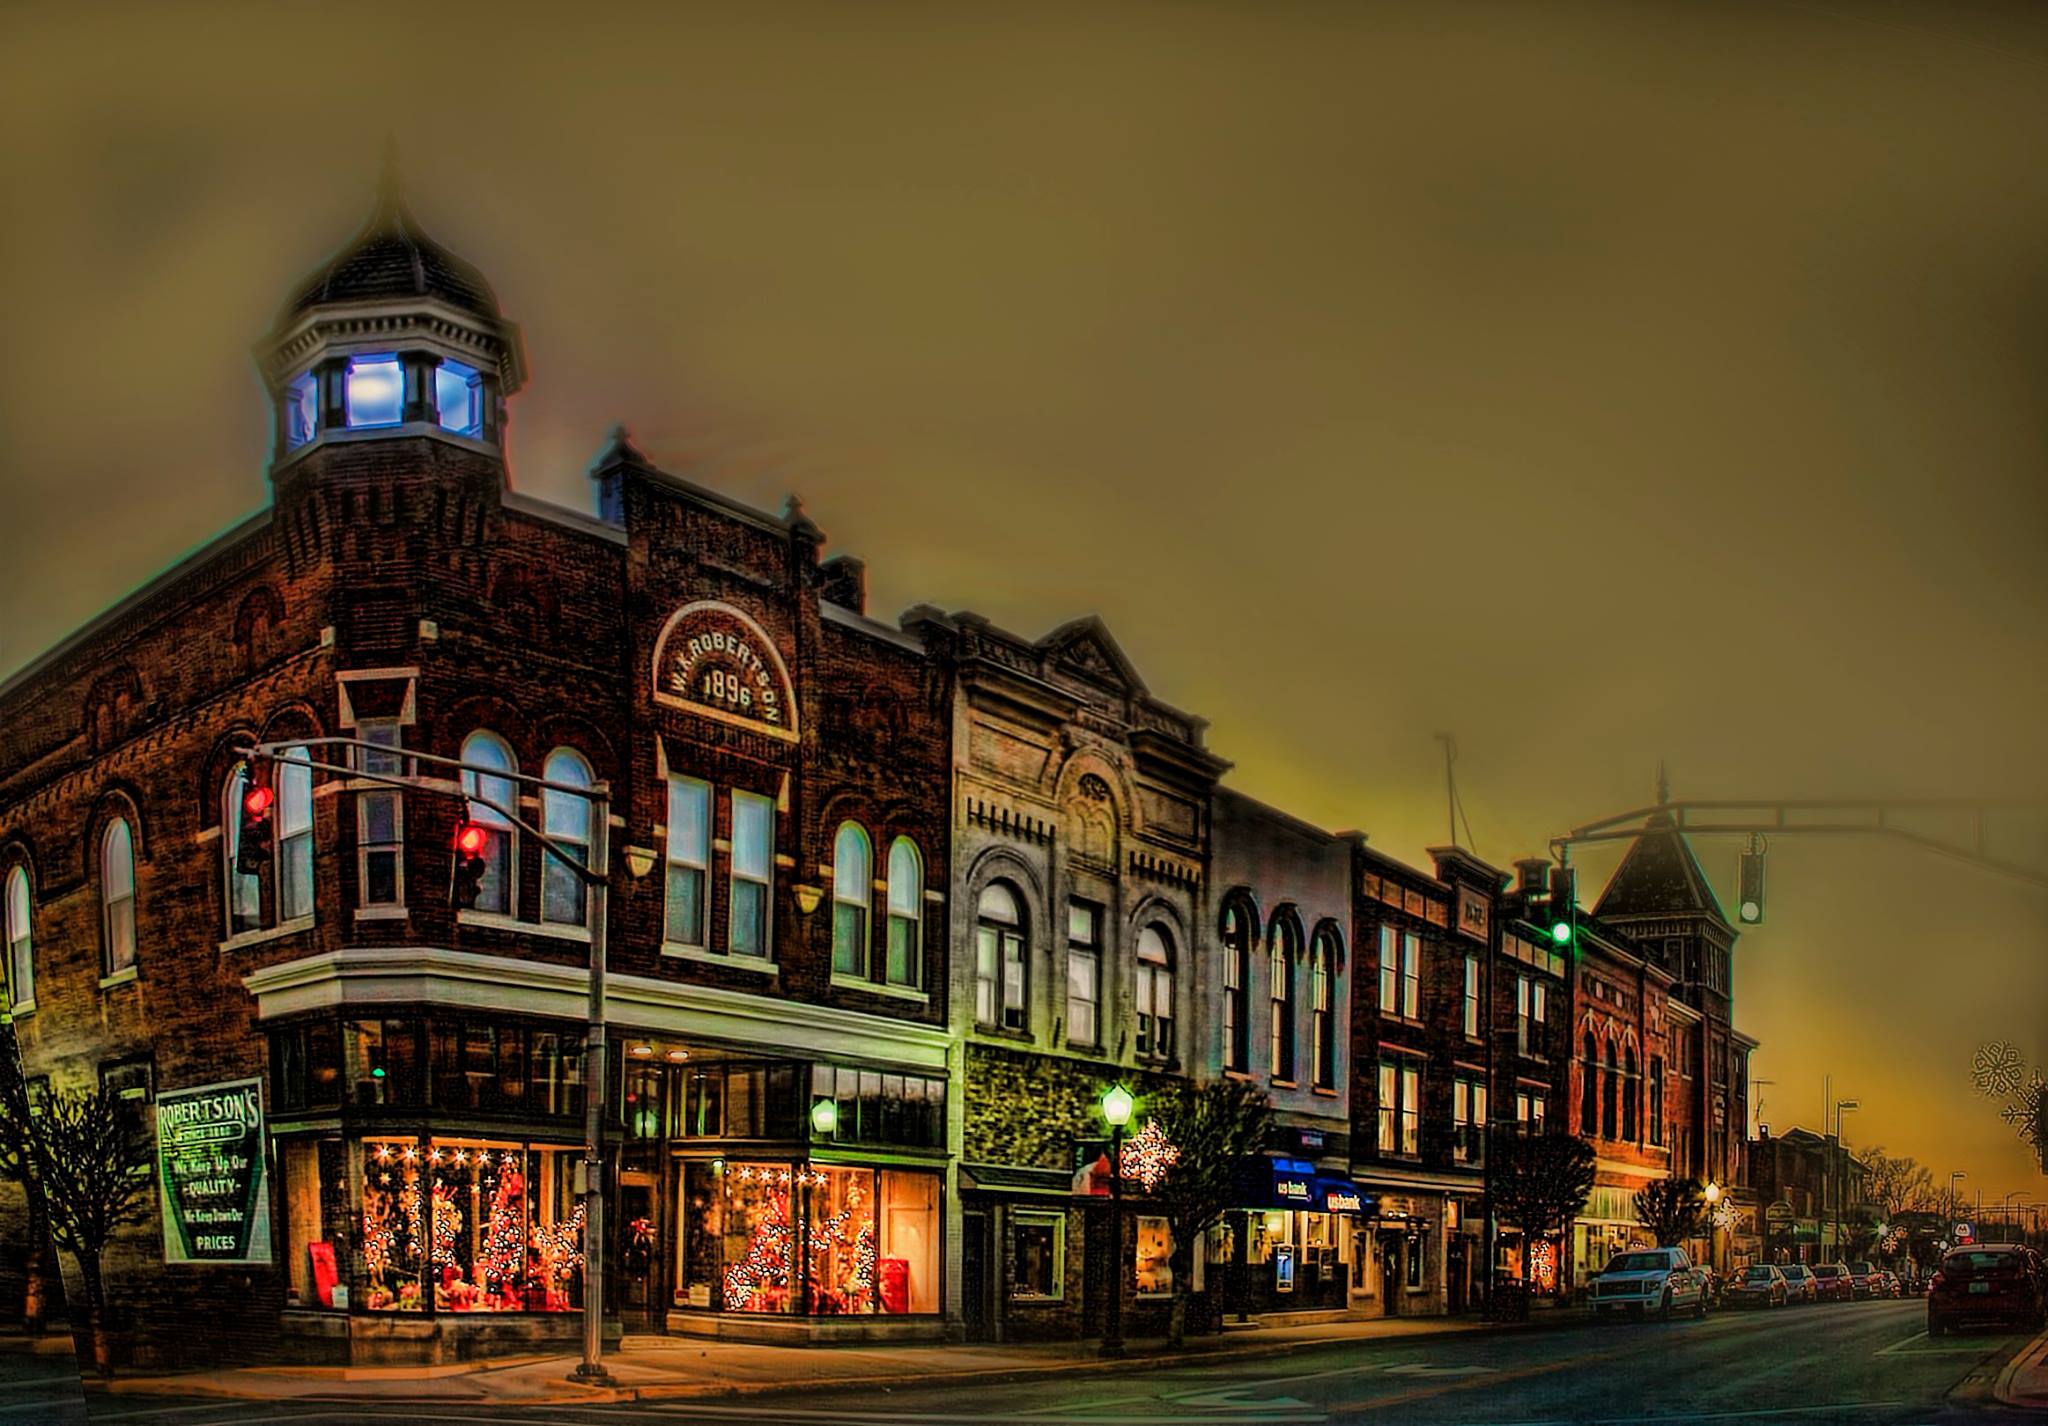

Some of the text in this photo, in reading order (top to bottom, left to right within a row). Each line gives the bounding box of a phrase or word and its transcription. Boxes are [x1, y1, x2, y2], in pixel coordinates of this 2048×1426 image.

[704, 669, 751, 706] 1896
[159, 1088, 259, 1142] ROBERTSON'S
[215, 1155, 229, 1174] Up
[231, 1154, 248, 1169] Our
[196, 1235, 236, 1250] PRICES
